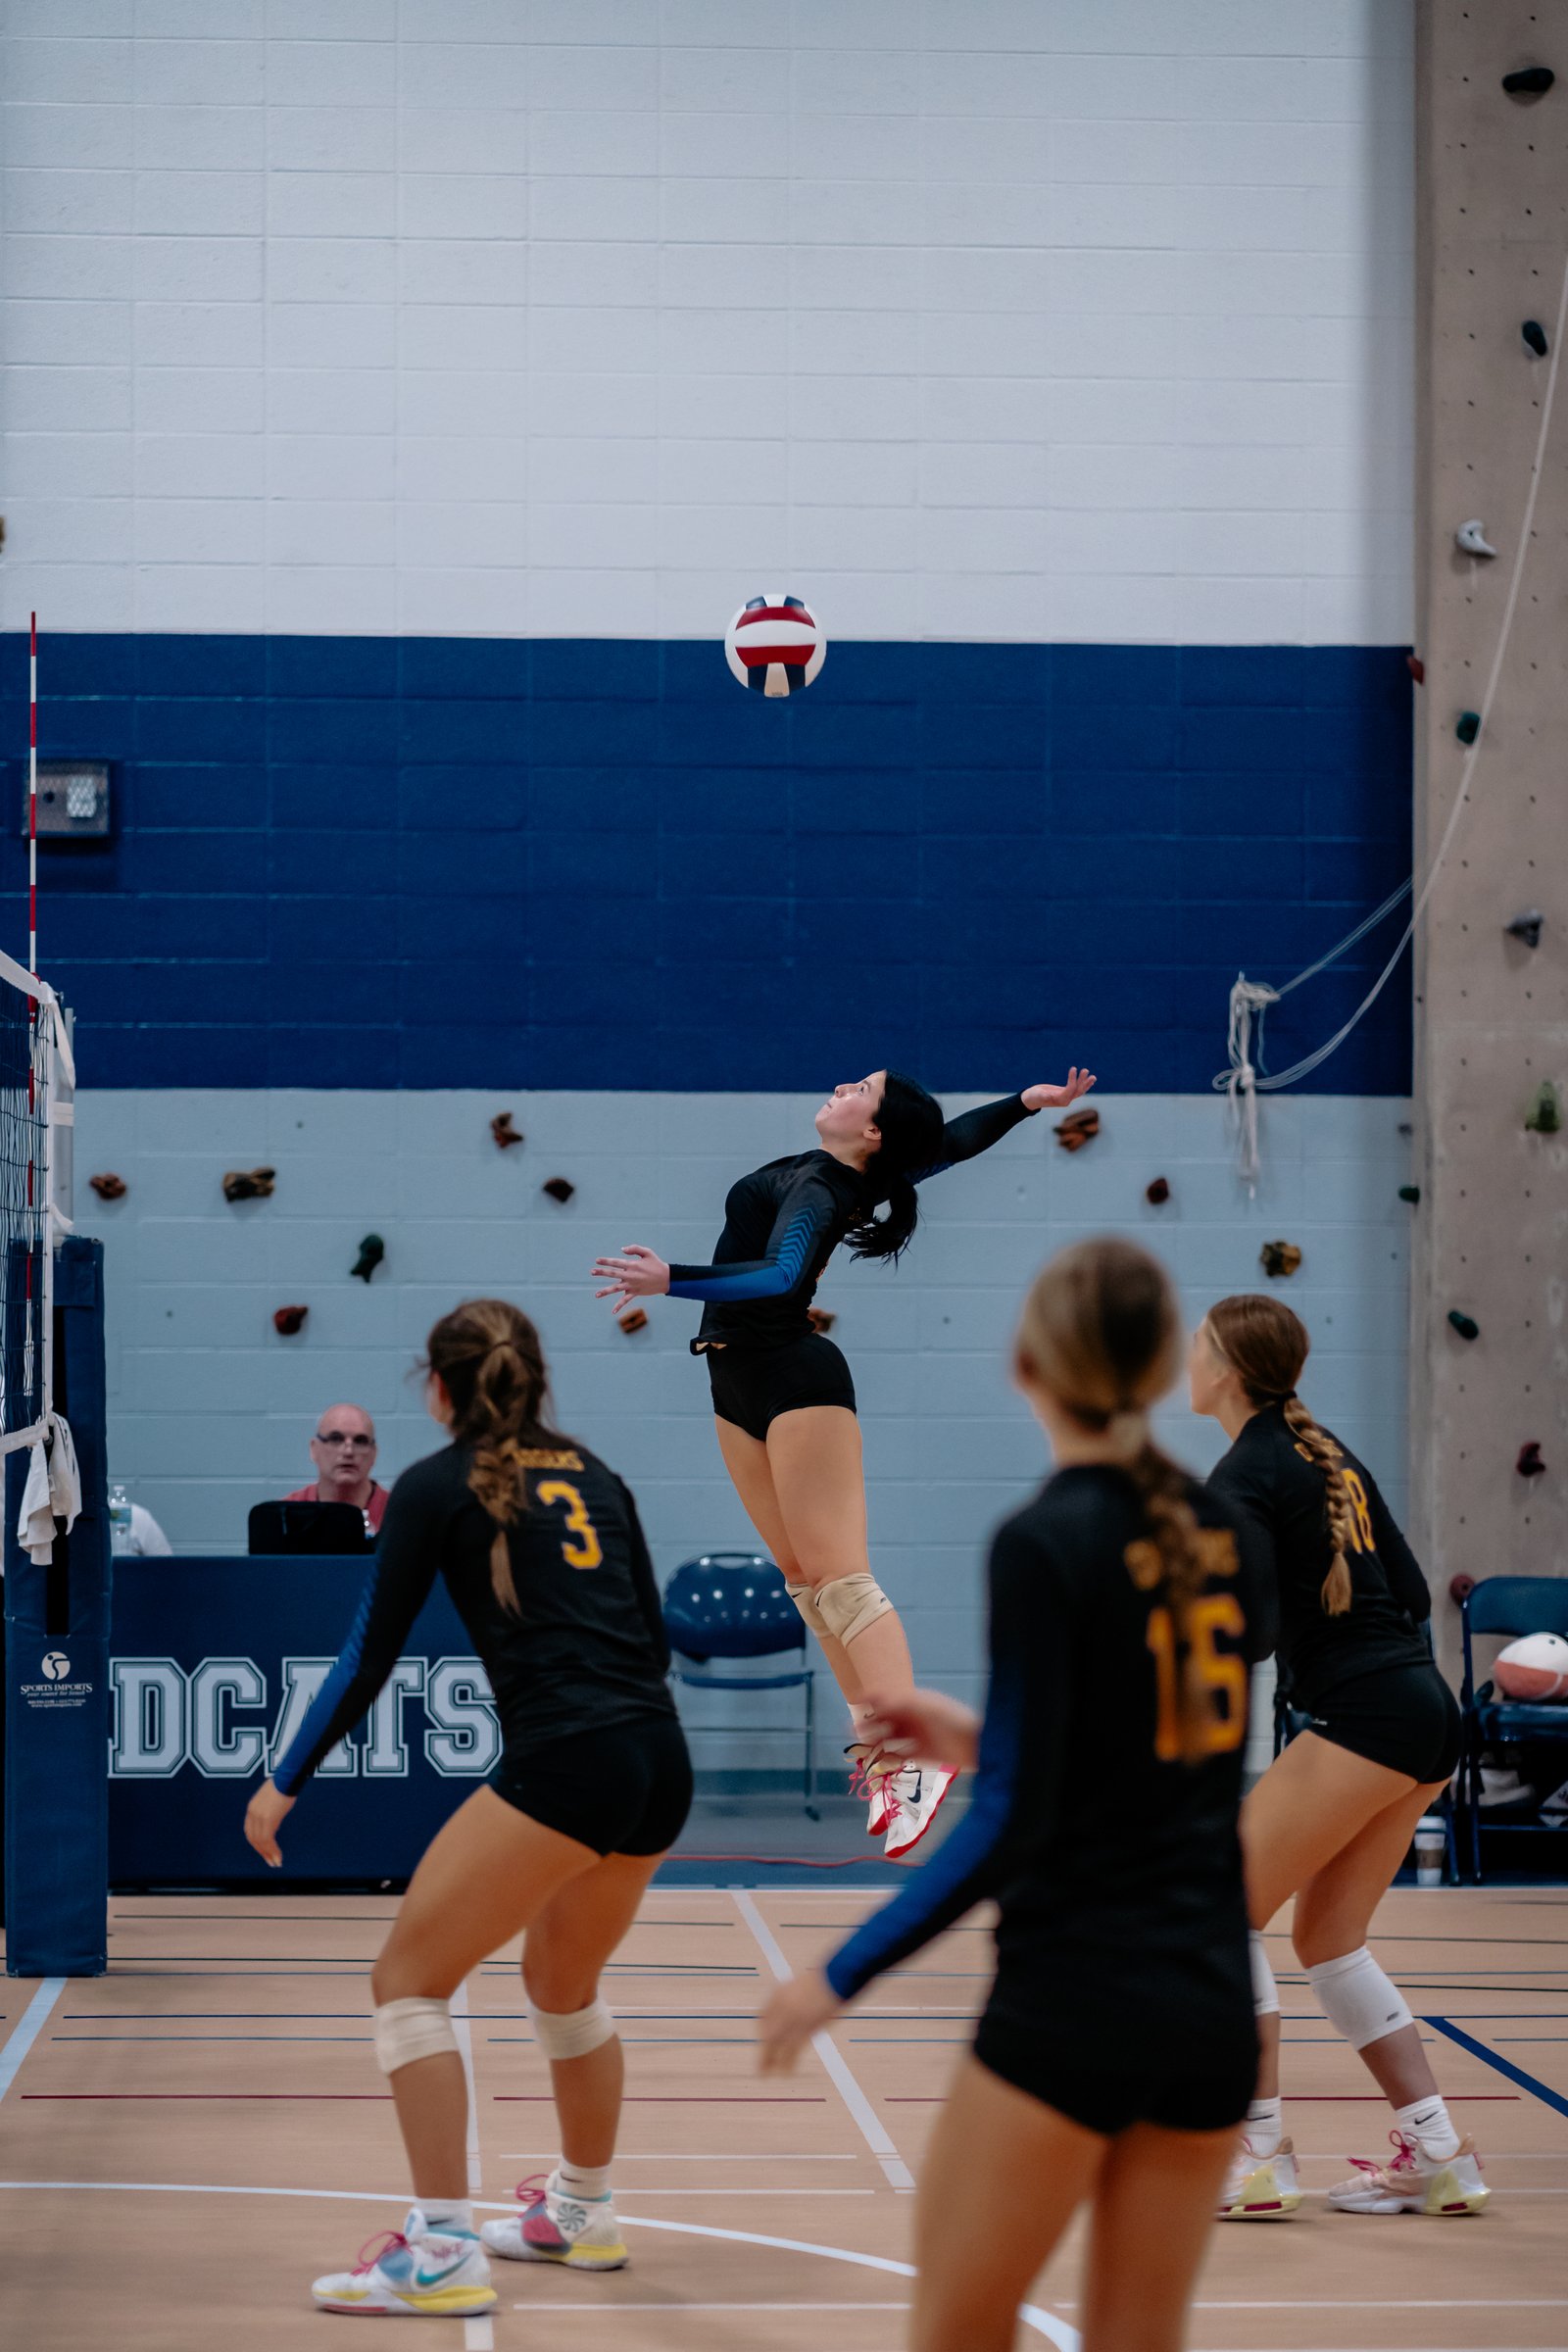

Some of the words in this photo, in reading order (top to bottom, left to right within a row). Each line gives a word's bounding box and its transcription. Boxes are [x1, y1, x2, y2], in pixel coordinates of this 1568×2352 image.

[536, 1480, 603, 1569] 3
[21, 1684, 53, 1694] SPORTS
[54, 1683, 93, 1693] IMPORTS
[1146, 1592, 1247, 1762] 16
